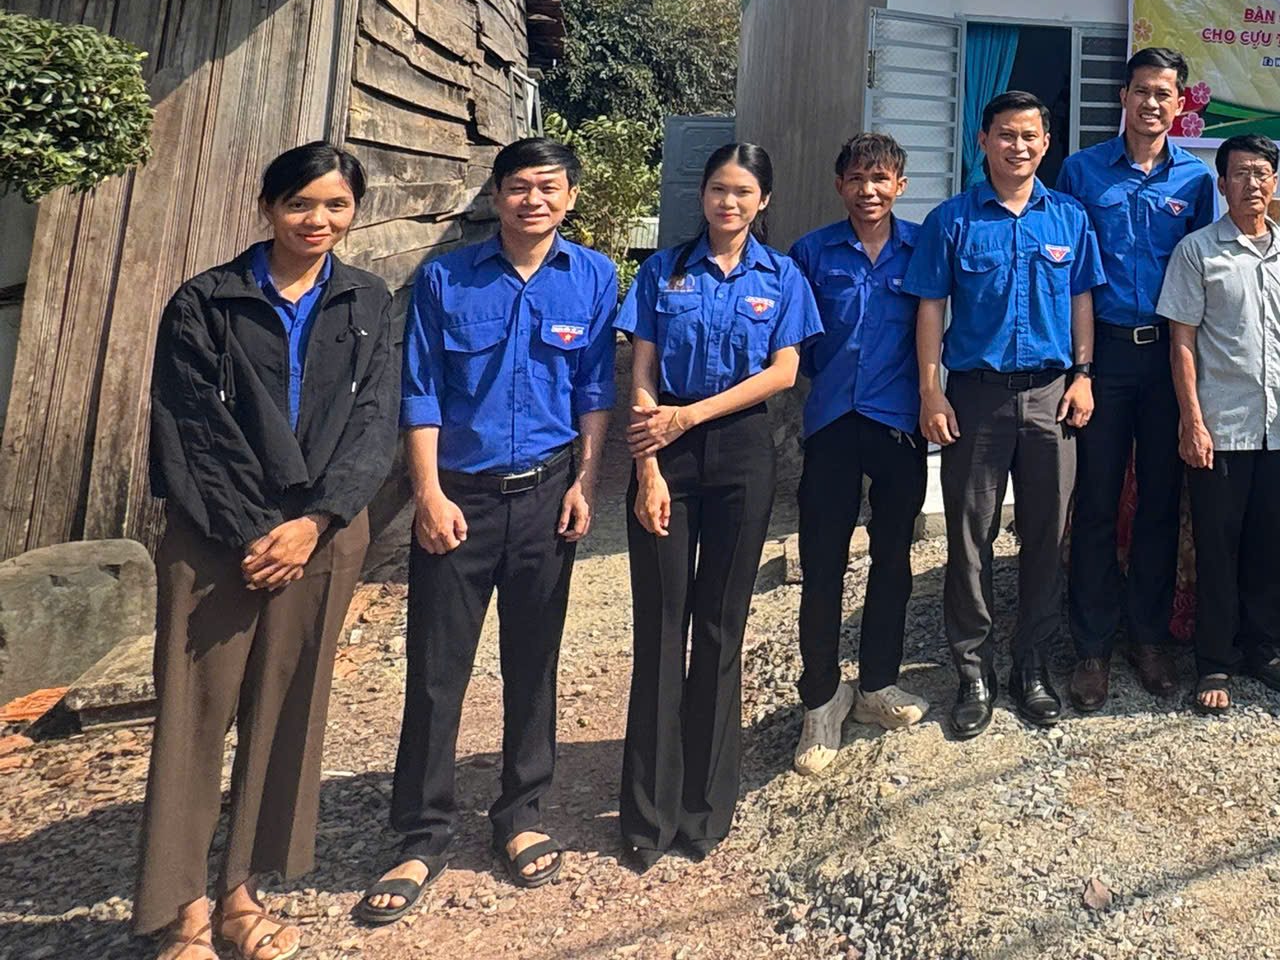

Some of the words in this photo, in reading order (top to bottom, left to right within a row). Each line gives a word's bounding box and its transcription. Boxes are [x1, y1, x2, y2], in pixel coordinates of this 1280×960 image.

[1244, 5, 1275, 24] BÀN
[1201, 28, 1236, 44] CHO
[1240, 30, 1272, 49] CỰU
